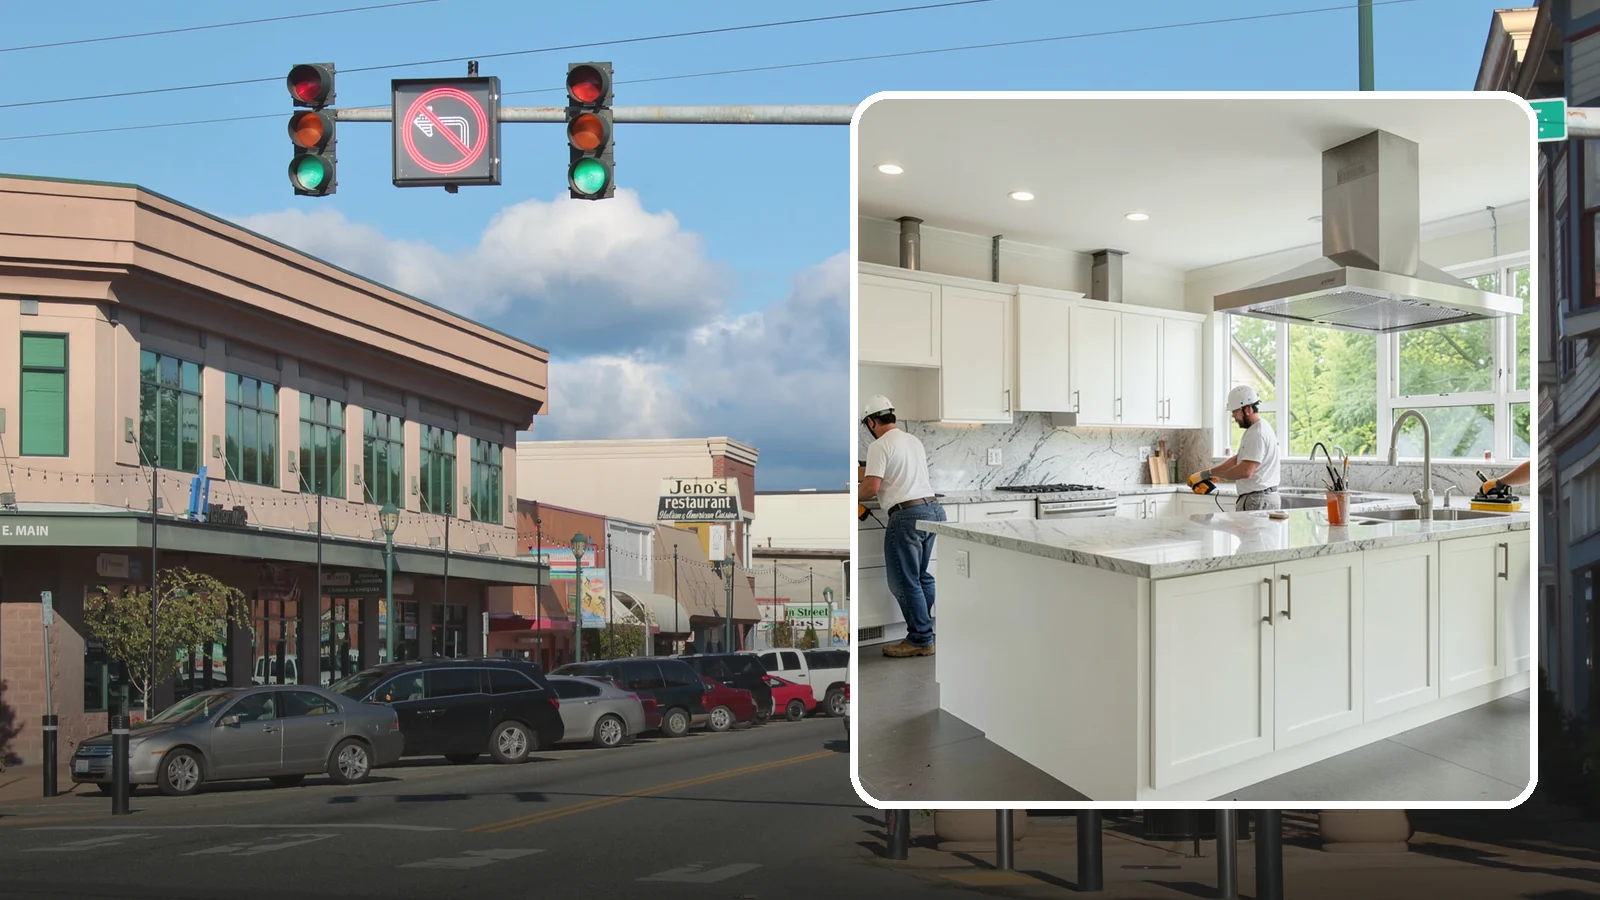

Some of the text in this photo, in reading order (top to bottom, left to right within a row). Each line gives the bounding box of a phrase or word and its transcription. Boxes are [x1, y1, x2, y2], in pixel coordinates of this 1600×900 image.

[669, 480, 728, 495] Jeno's
[665, 496, 731, 509] restaurant
[658, 509, 682, 520] Italian
[686, 509, 714, 520] American
[715, 509, 738, 520] Cuisine
[2, 525, 49, 536] E. MAIN
[797, 607, 829, 617] Street
[791, 619, 824, 627] lass
